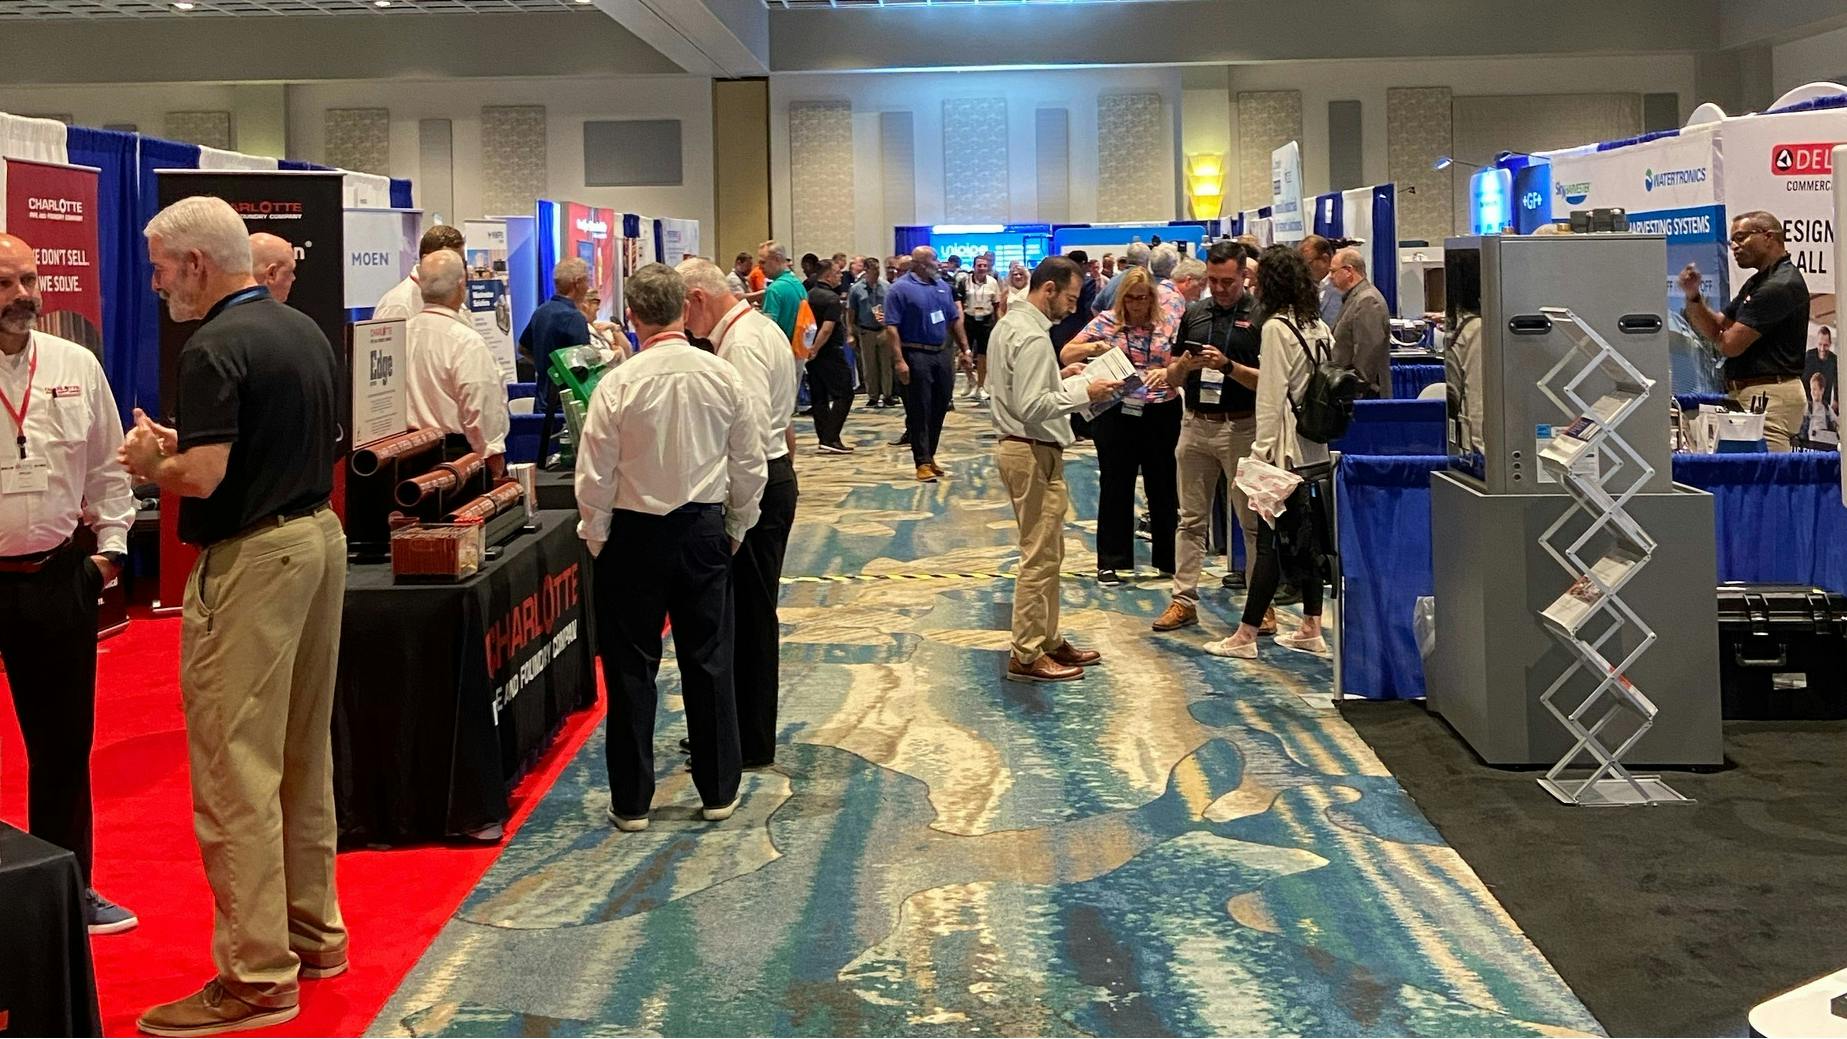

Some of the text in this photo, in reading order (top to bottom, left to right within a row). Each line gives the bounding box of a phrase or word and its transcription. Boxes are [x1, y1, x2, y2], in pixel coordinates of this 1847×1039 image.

[1796, 149, 1833, 170] DEL
[1653, 168, 1706, 187] WATERTRONICS
[1786, 181, 1833, 192] COMMERC
[28, 197, 83, 213] CHARLOTTE
[232, 201, 303, 213] ARLOTTE
[1673, 214, 1710, 235] SYSTEMS
[1783, 220, 1834, 243] ESIGN
[41, 248, 66, 266] DON'T
[67, 250, 90, 266] SELL.
[352, 252, 389, 266] MOEN
[1797, 250, 1827, 274] ALL
[54, 276, 82, 292] SOLVE.
[370, 349, 393, 386] Edge
[484, 562, 579, 680] CHARLOTTE
[520, 640, 552, 689] FOUNDRY
